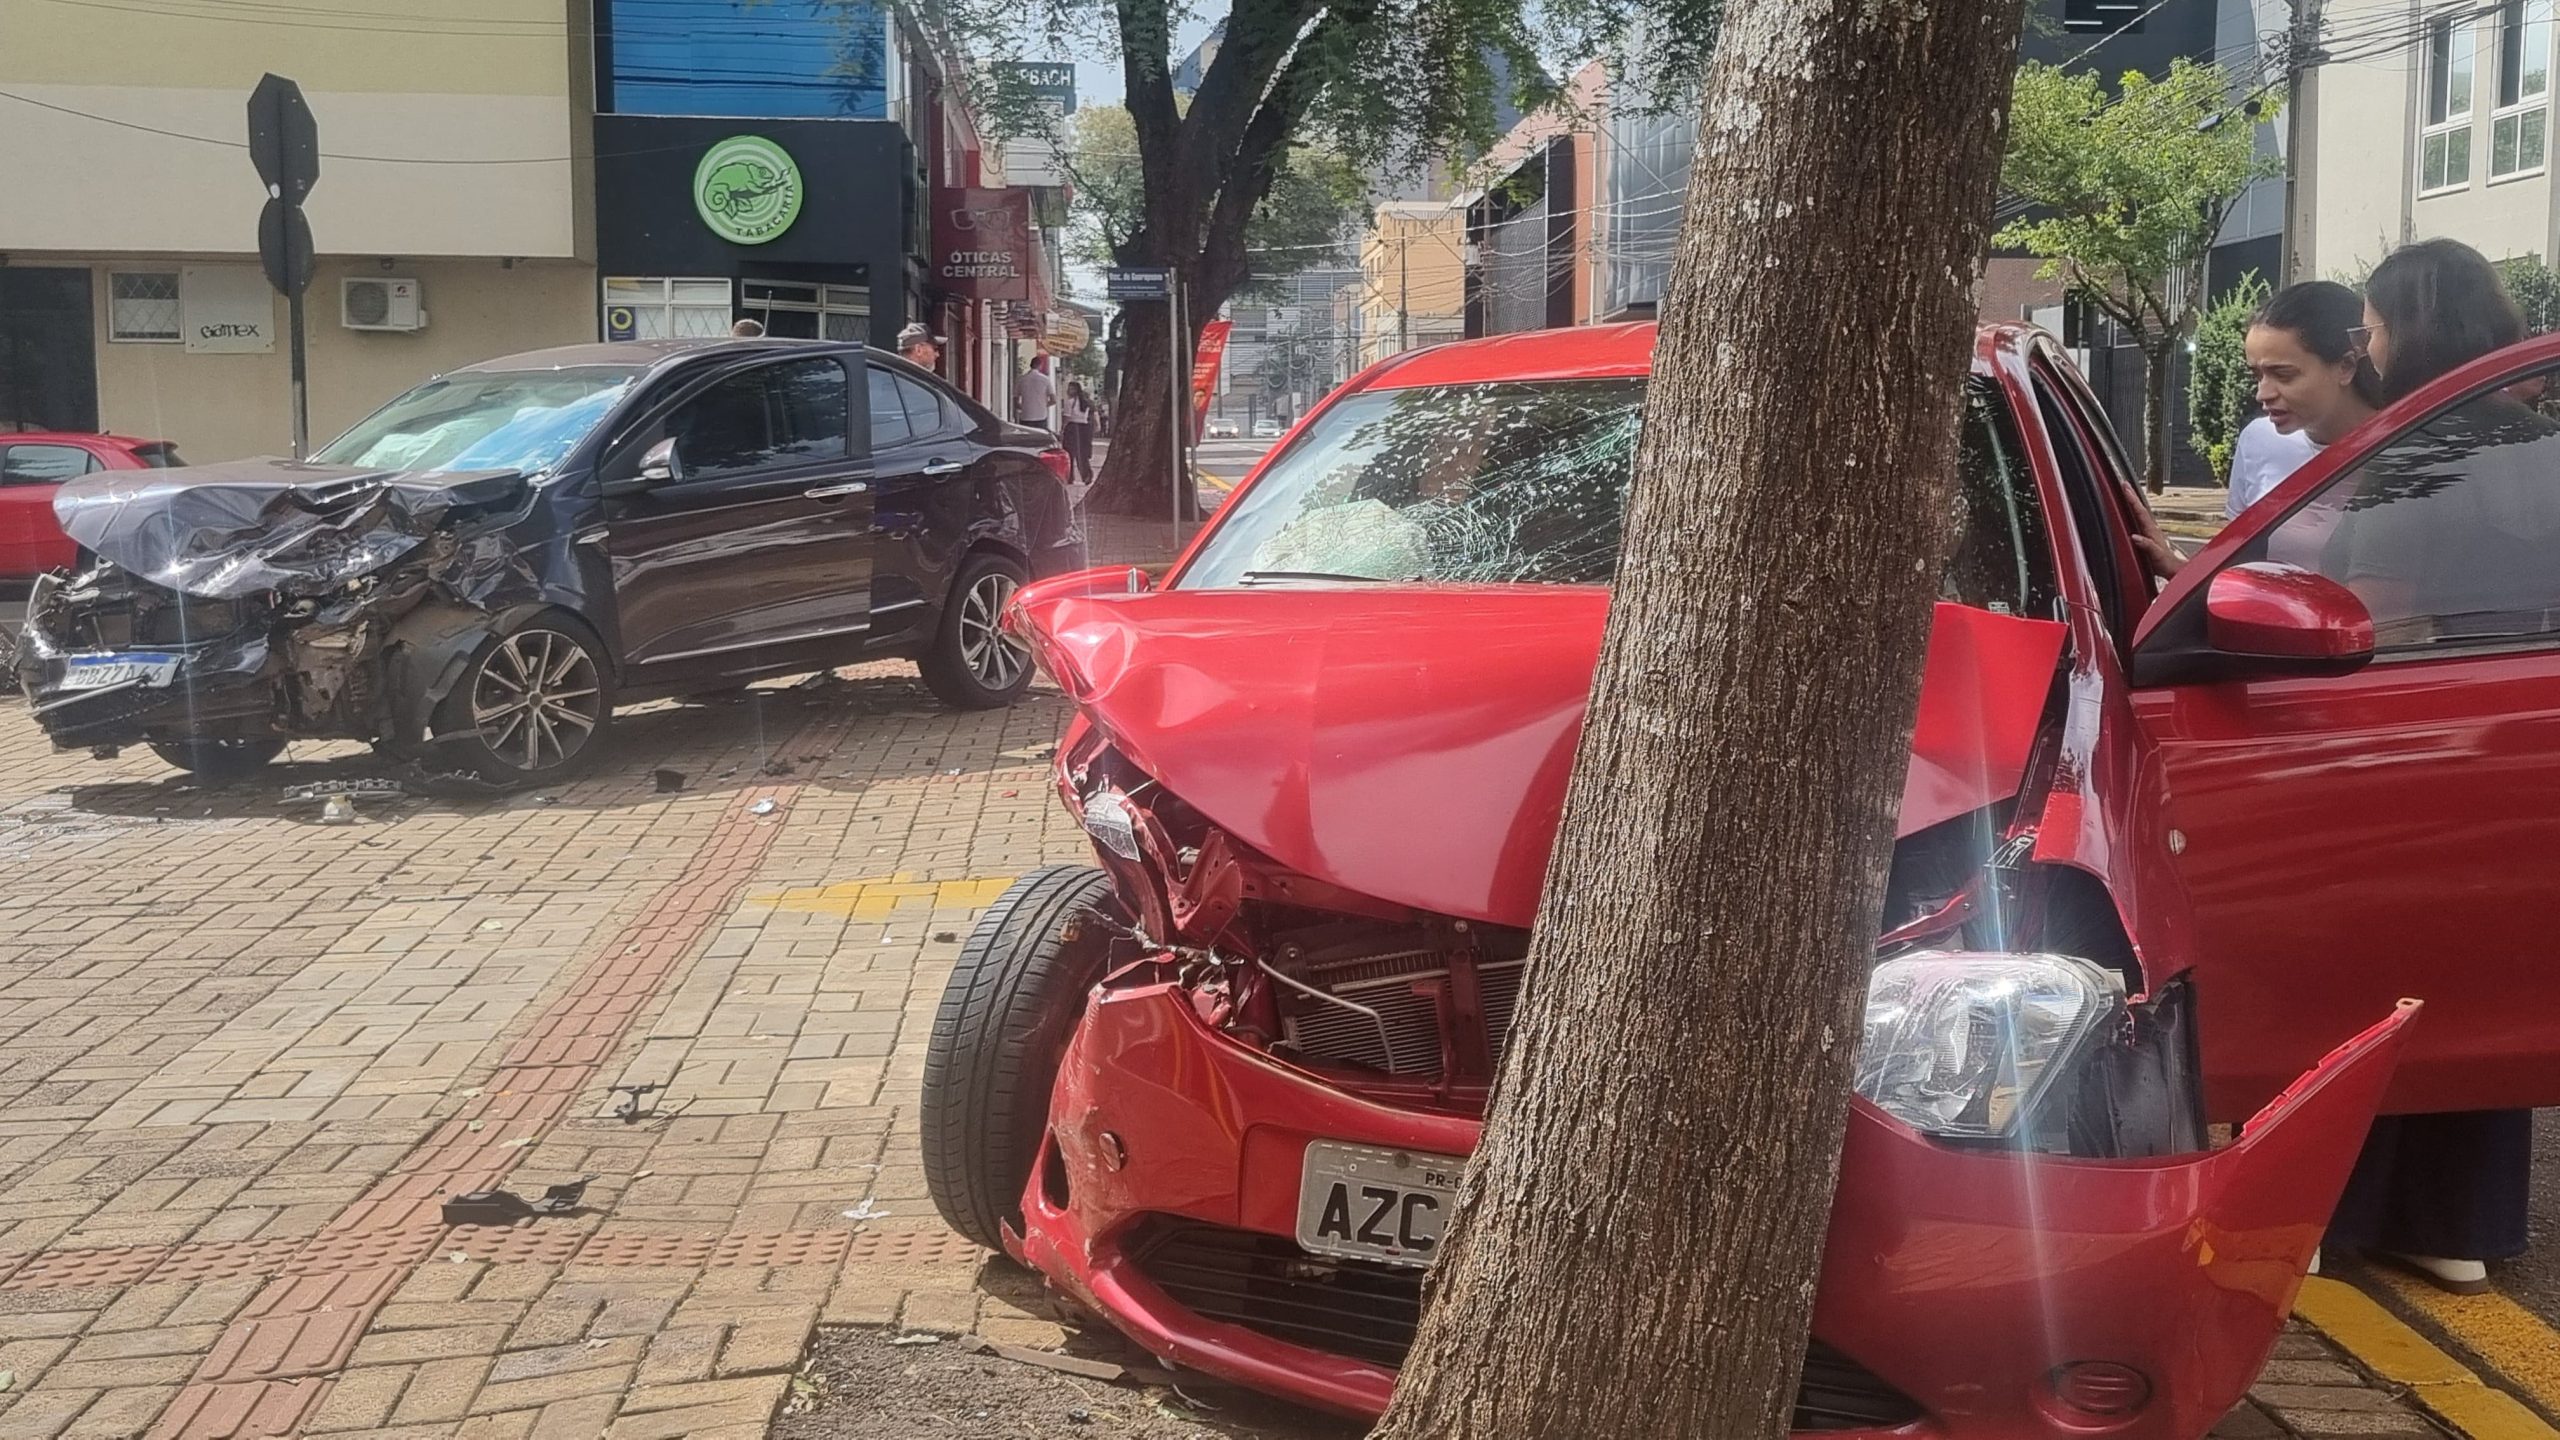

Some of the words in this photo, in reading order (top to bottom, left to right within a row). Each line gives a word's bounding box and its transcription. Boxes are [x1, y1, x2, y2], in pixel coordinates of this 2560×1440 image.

[735, 184, 795, 237] TABACARIA
[950, 249, 1012, 264] ÓTICAS
[942, 265, 1020, 278] CENTRAL
